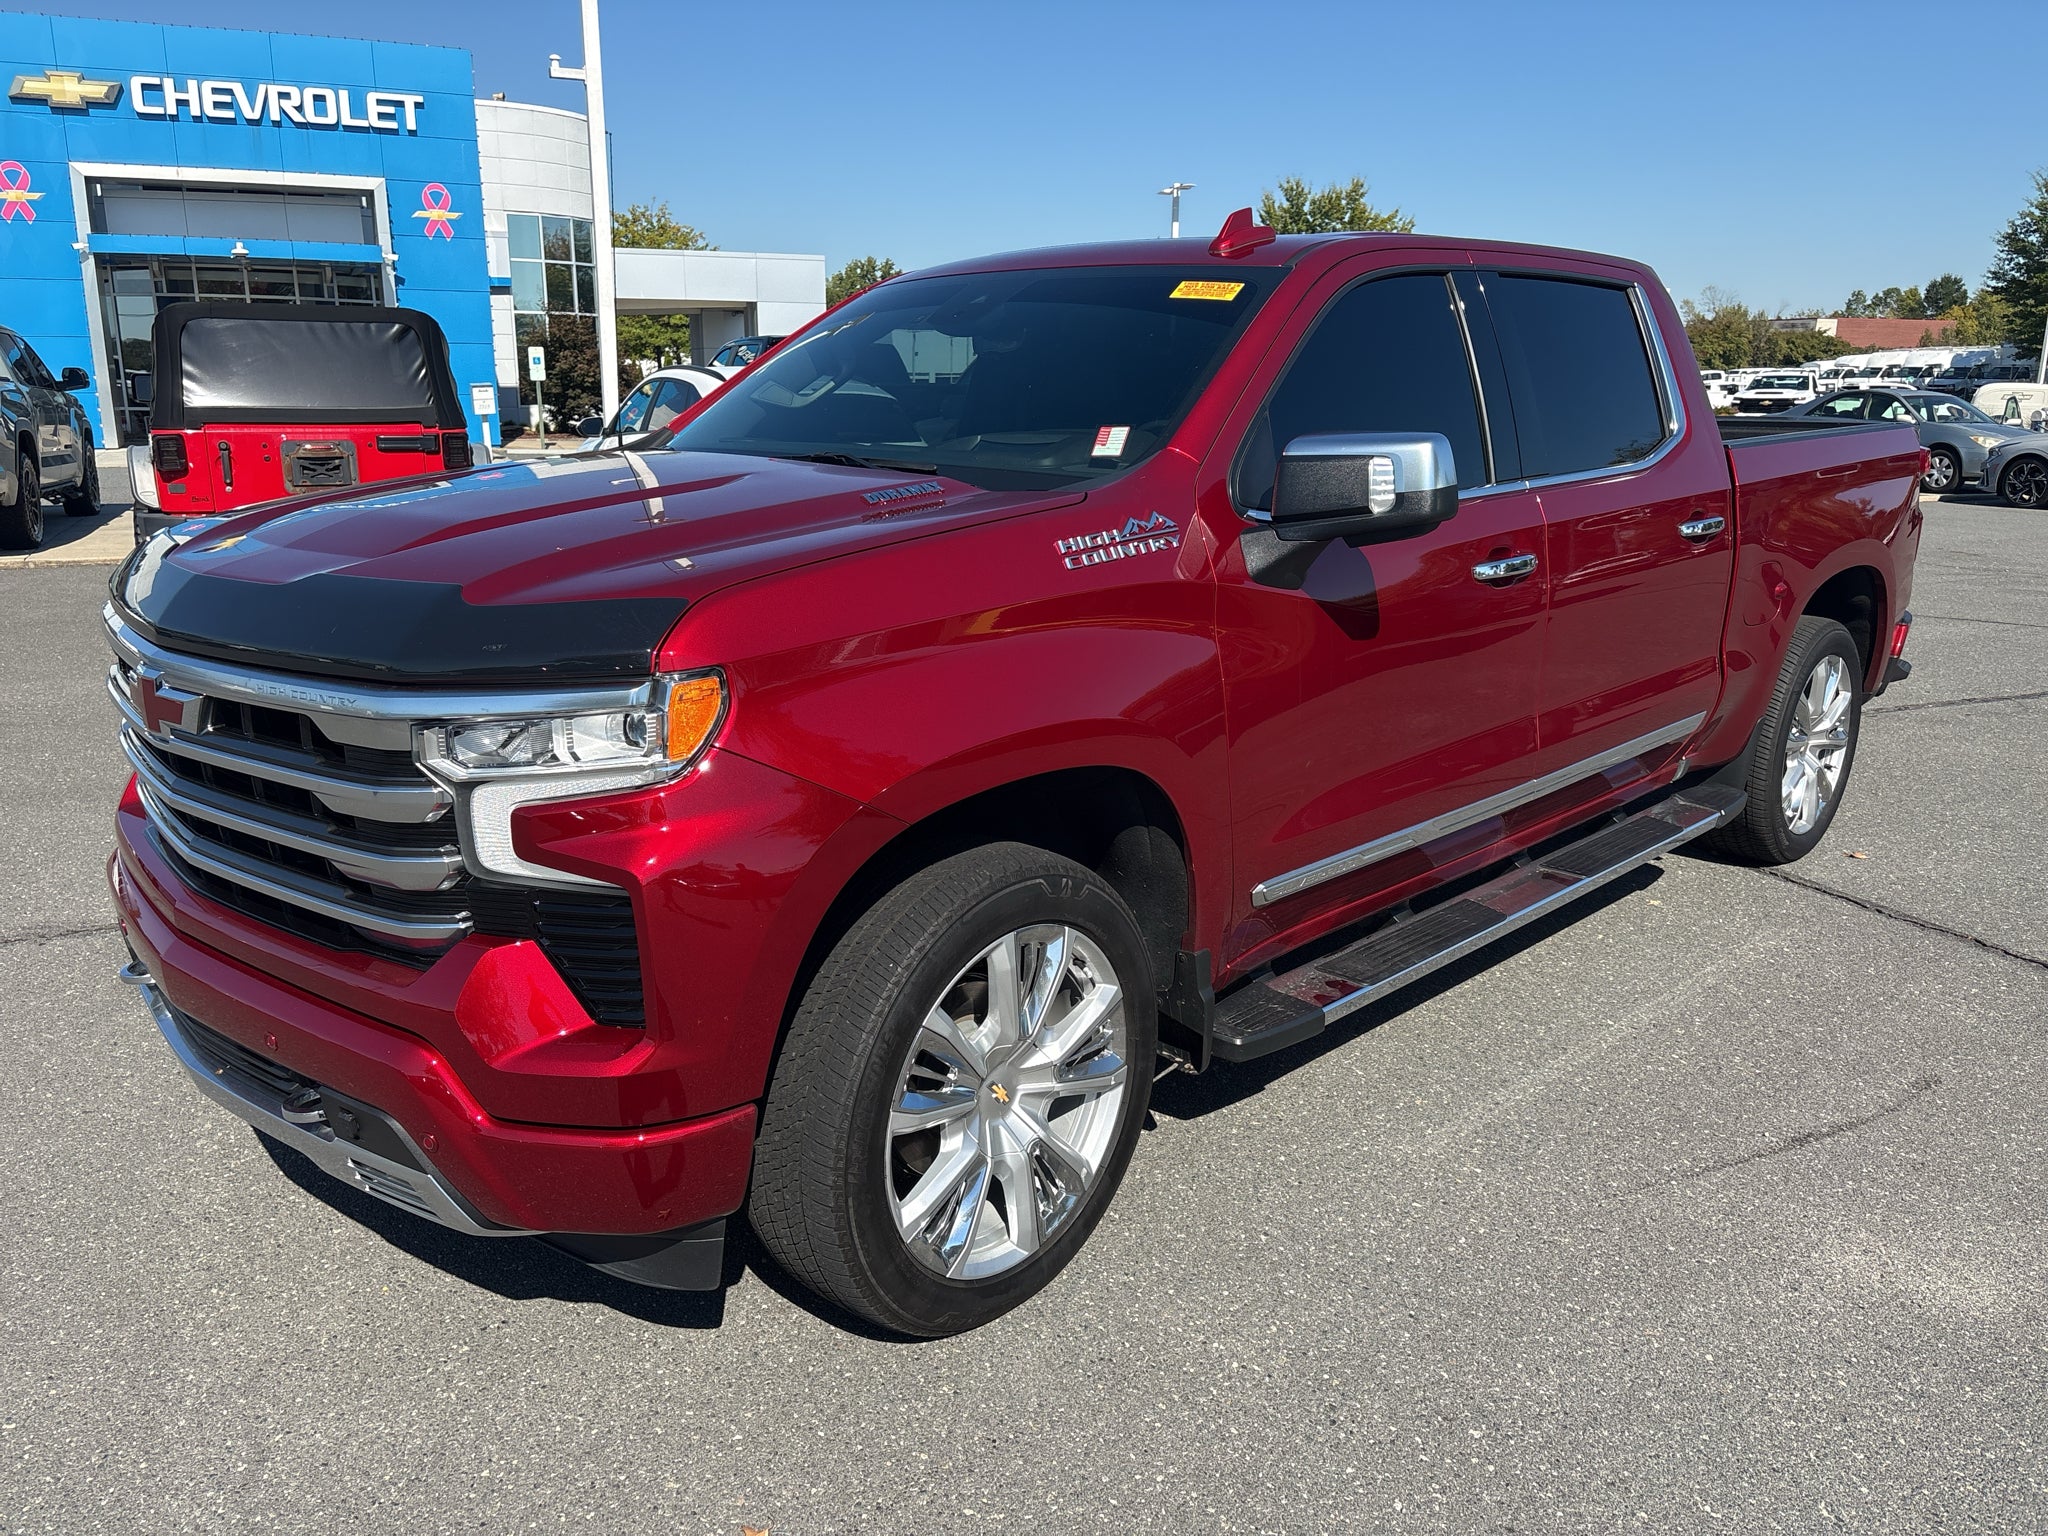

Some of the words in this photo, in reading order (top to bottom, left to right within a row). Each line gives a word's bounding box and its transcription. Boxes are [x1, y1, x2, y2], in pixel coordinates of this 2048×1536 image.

[129, 75, 424, 131] CHEVROLET
[862, 481, 945, 505] DURAMAX
[1056, 529, 1121, 555] HIGH
[1063, 534, 1181, 570] COUNTRY
[256, 684, 287, 696] HIGH
[290, 689, 357, 708] COUNTRY
